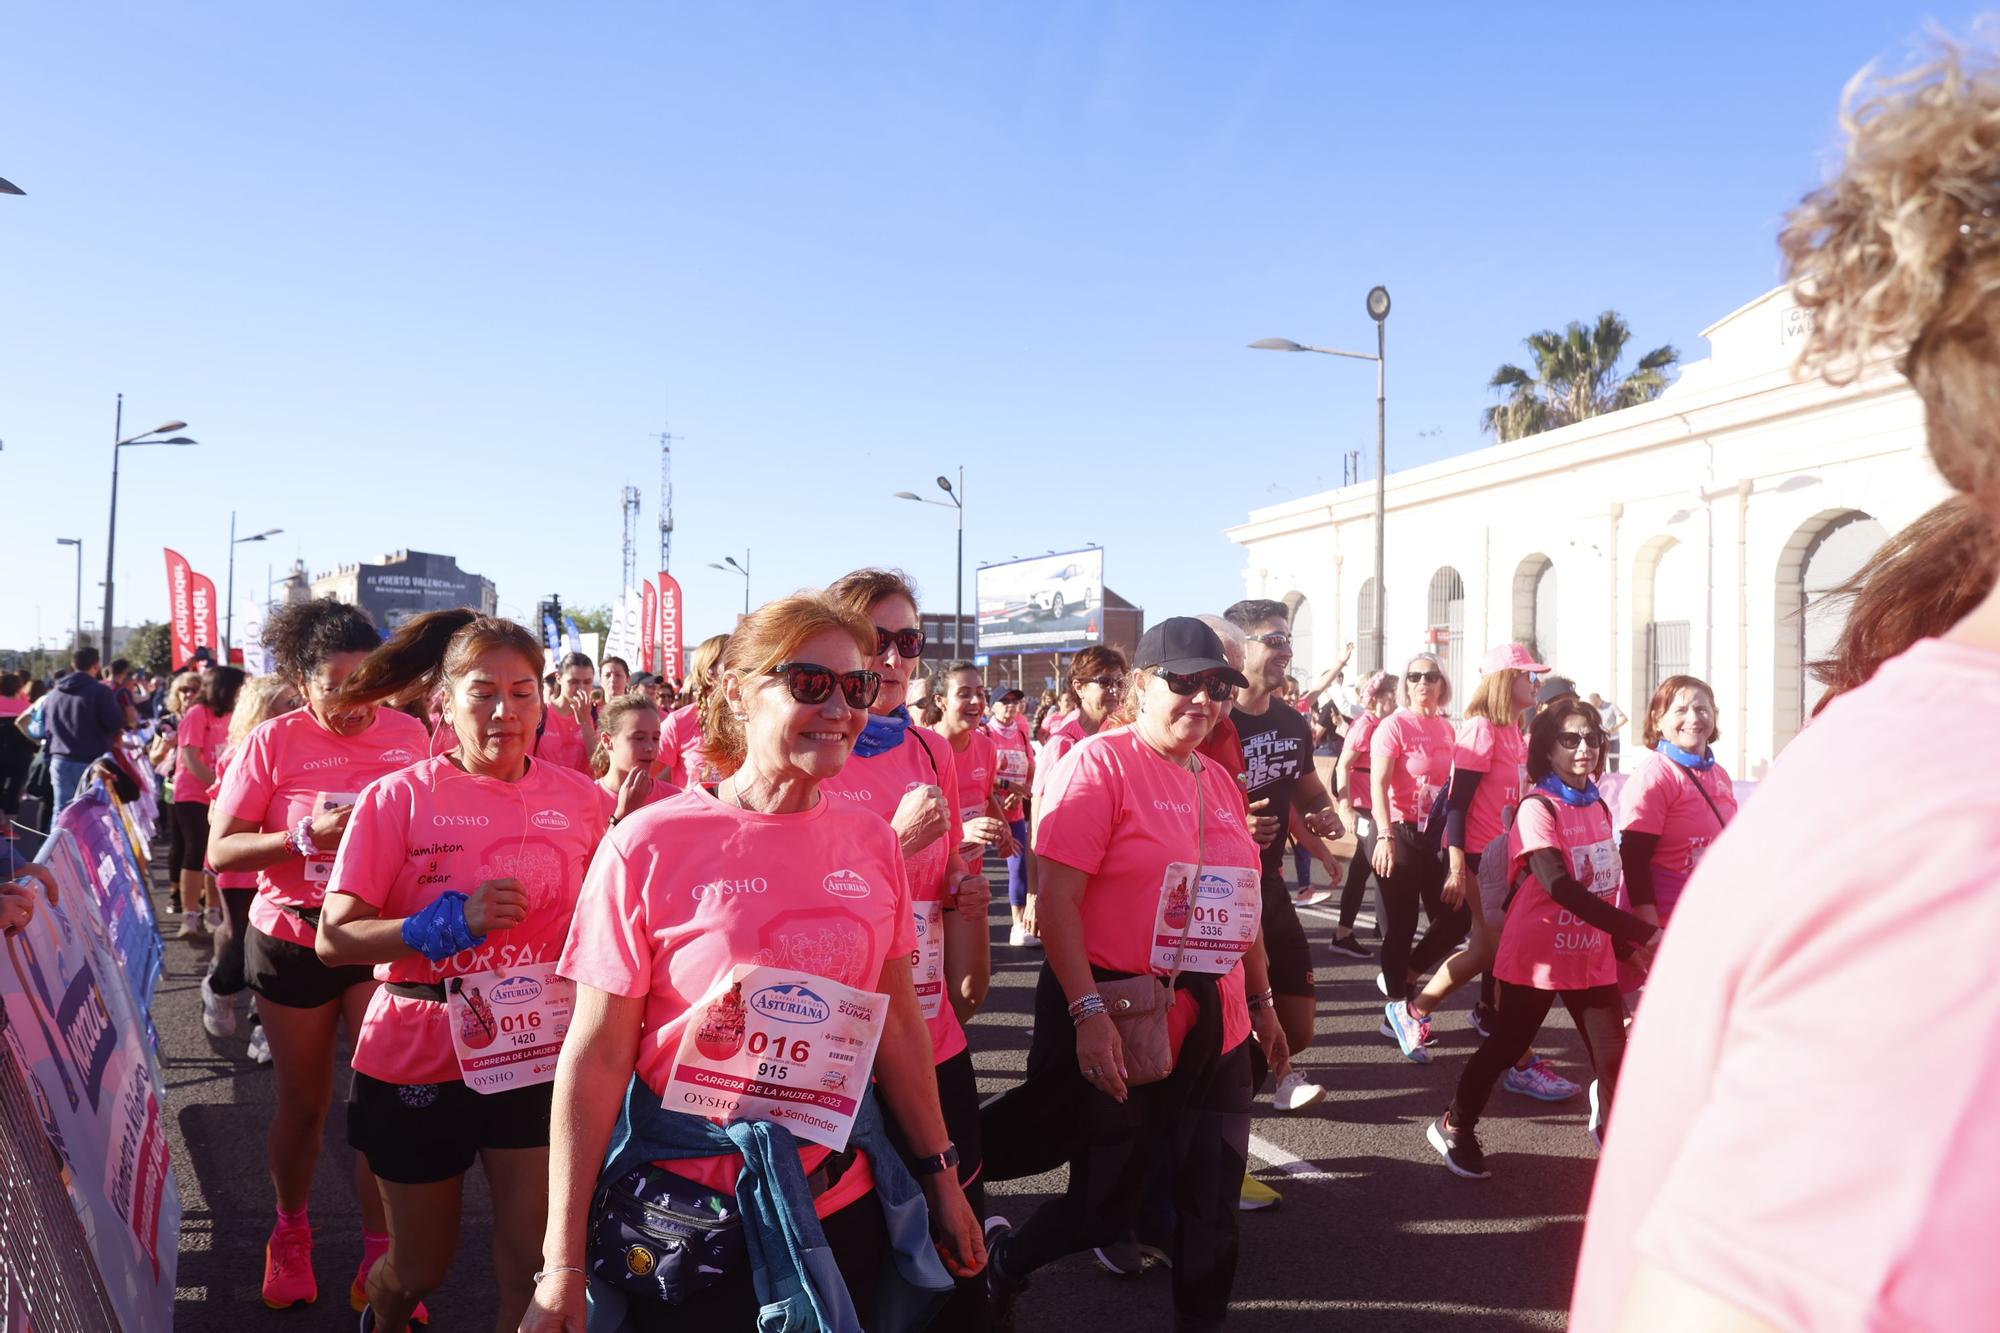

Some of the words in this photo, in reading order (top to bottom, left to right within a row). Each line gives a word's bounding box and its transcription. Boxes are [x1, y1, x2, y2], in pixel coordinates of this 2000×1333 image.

[378, 575, 410, 586] PUERTO
[1243, 740, 1298, 758] ETTER.
[303, 756, 349, 770] OYSHO
[1153, 800, 1191, 814] OYHO
[433, 815, 490, 827] OYSHO
[430, 861, 437, 872] y
[417, 874, 451, 885] Cesar
[691, 877, 768, 901] OYSHO
[1197, 885, 1230, 894] TURIANA
[1194, 906, 1229, 923] 016
[1200, 925, 1223, 936] 3336
[1168, 938, 1199, 947] CARERA
[1163, 952, 1198, 964] OYHO
[495, 987, 539, 1000] ASTURIANA
[756, 994, 822, 1019] ASTURIANA
[837, 1005, 871, 1021] SUMA
[500, 1011, 541, 1032] 016
[511, 1032, 536, 1046] 1420
[748, 1031, 811, 1062] 016
[473, 1055, 511, 1068] CARRERA
[512, 1052, 523, 1061] DE
[523, 1050, 532, 1058] LA
[533, 1046, 557, 1057] MUJER
[474, 1071, 514, 1087] OYSHO
[758, 1063, 788, 1080] 915
[695, 1073, 745, 1090] CARRERA
[747, 1084, 762, 1094] DE
[764, 1087, 777, 1097] LA
[779, 1090, 816, 1101] MUJER
[817, 1095, 842, 1108] 2023
[684, 1092, 740, 1111] OYSHO
[783, 1109, 838, 1133] Santander
